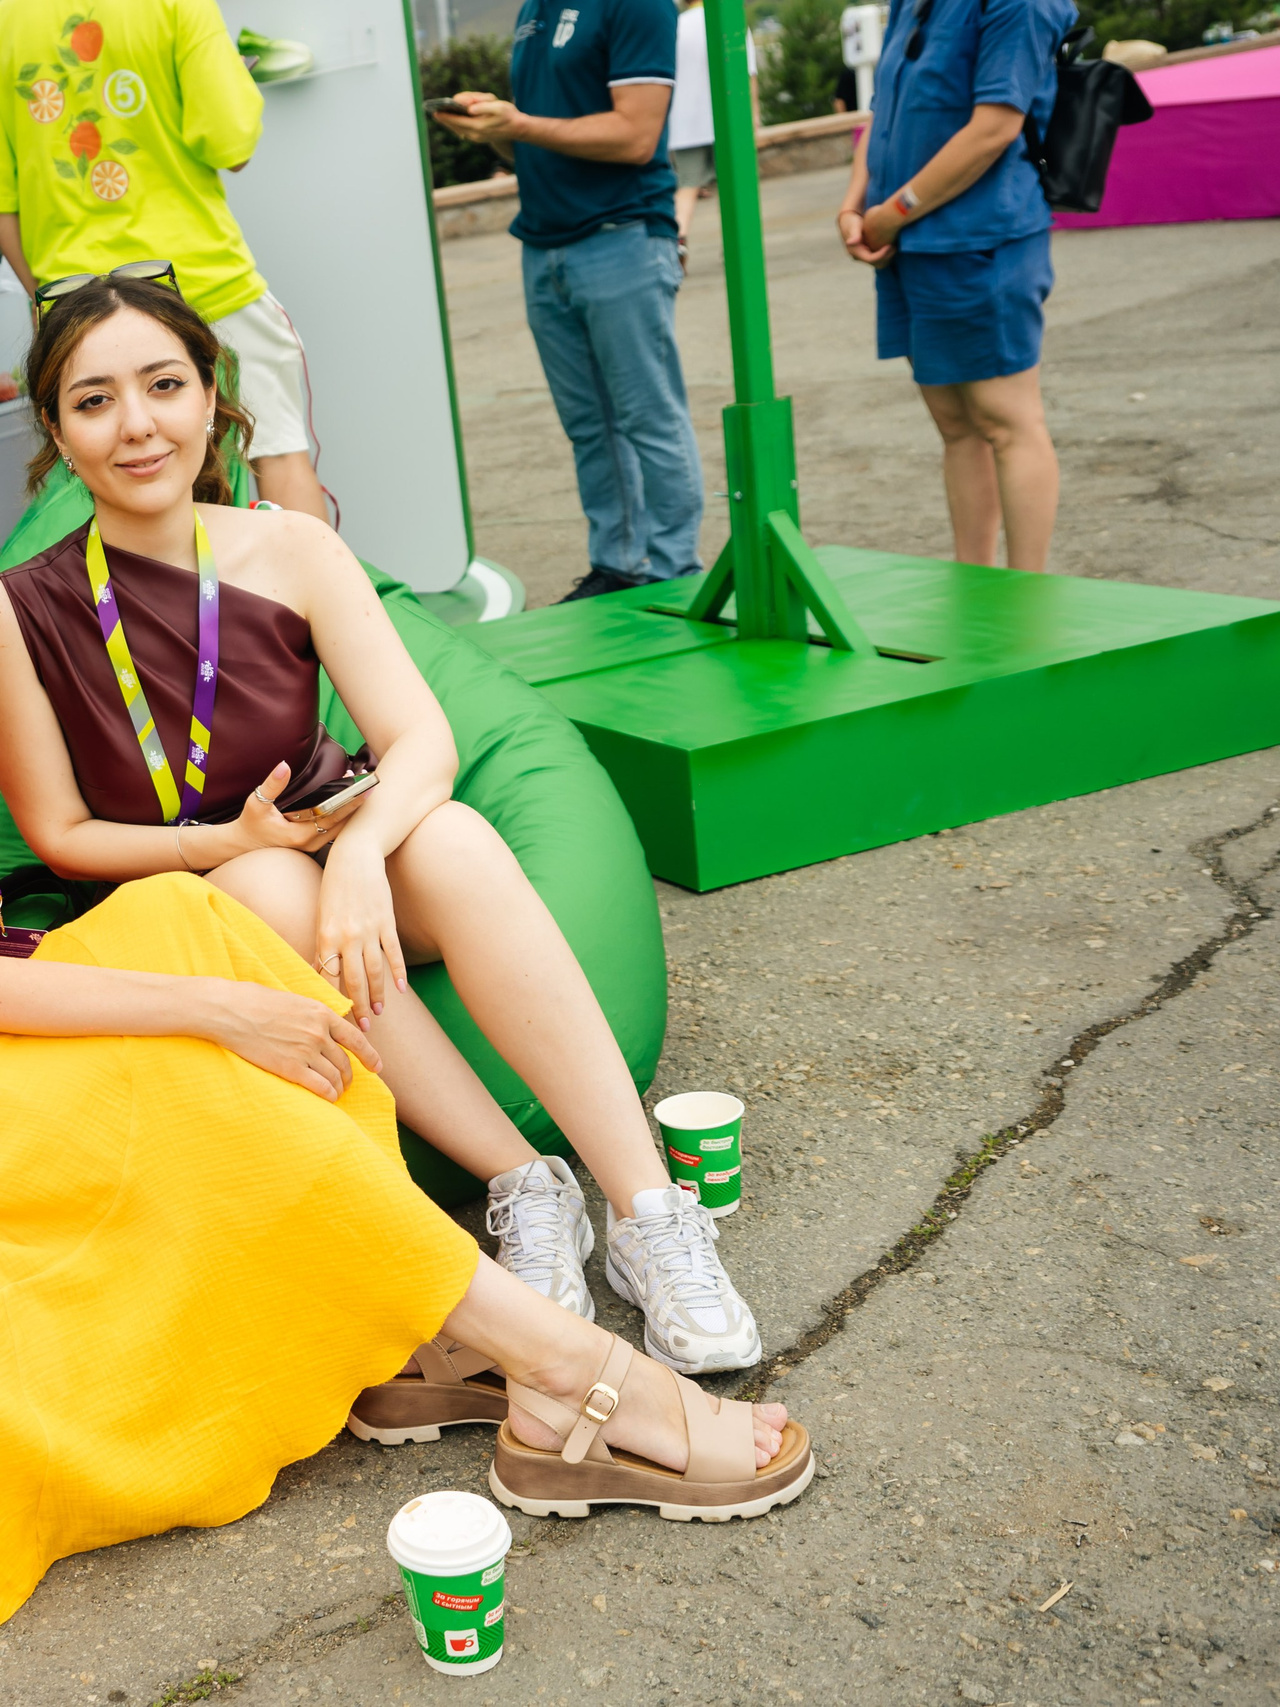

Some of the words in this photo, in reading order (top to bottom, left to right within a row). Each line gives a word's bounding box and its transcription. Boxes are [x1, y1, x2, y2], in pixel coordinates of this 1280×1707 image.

[115, 76, 135, 109] 5
[436, 1592, 446, 1600] За
[446, 1596, 480, 1604] горячим
[441, 1601, 473, 1610] сытным
